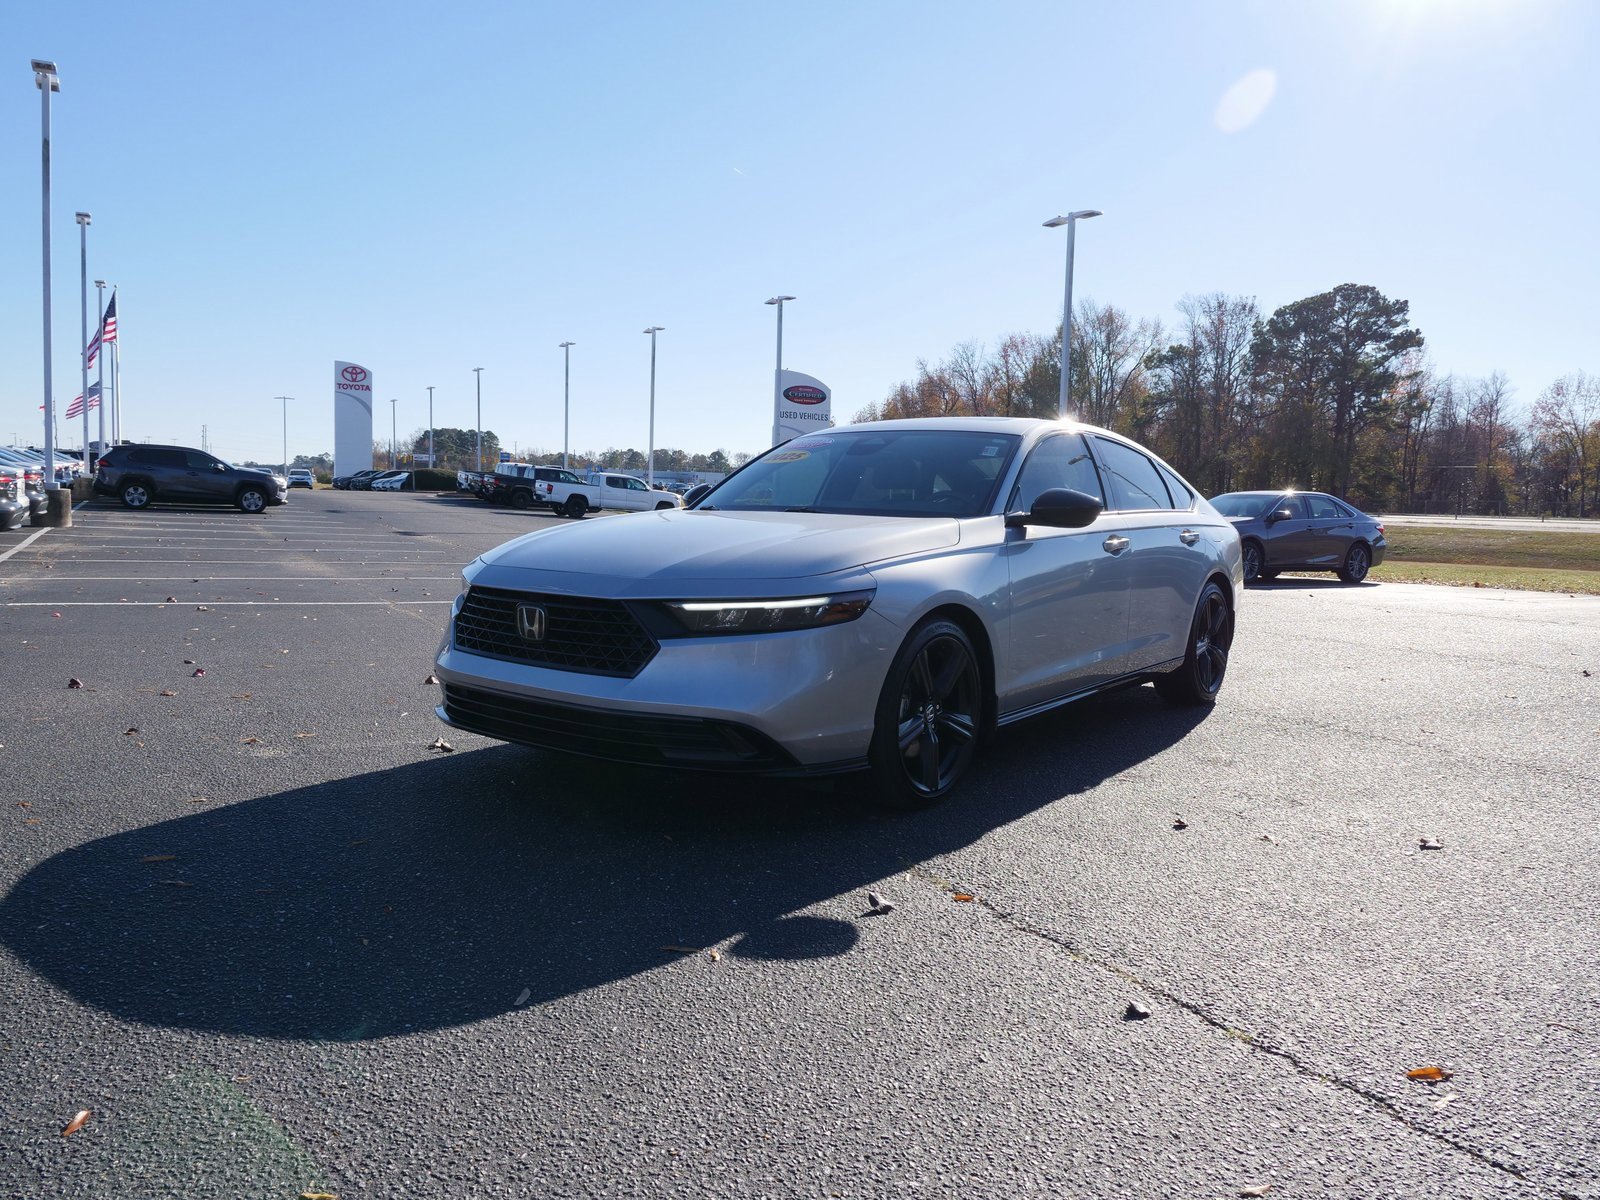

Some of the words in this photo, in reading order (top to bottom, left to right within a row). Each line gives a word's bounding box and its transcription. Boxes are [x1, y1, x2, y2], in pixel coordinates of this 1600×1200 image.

[336, 383, 371, 391] TOYOTA
[779, 411, 798, 419] USED
[799, 412, 829, 421] VEHICLES
